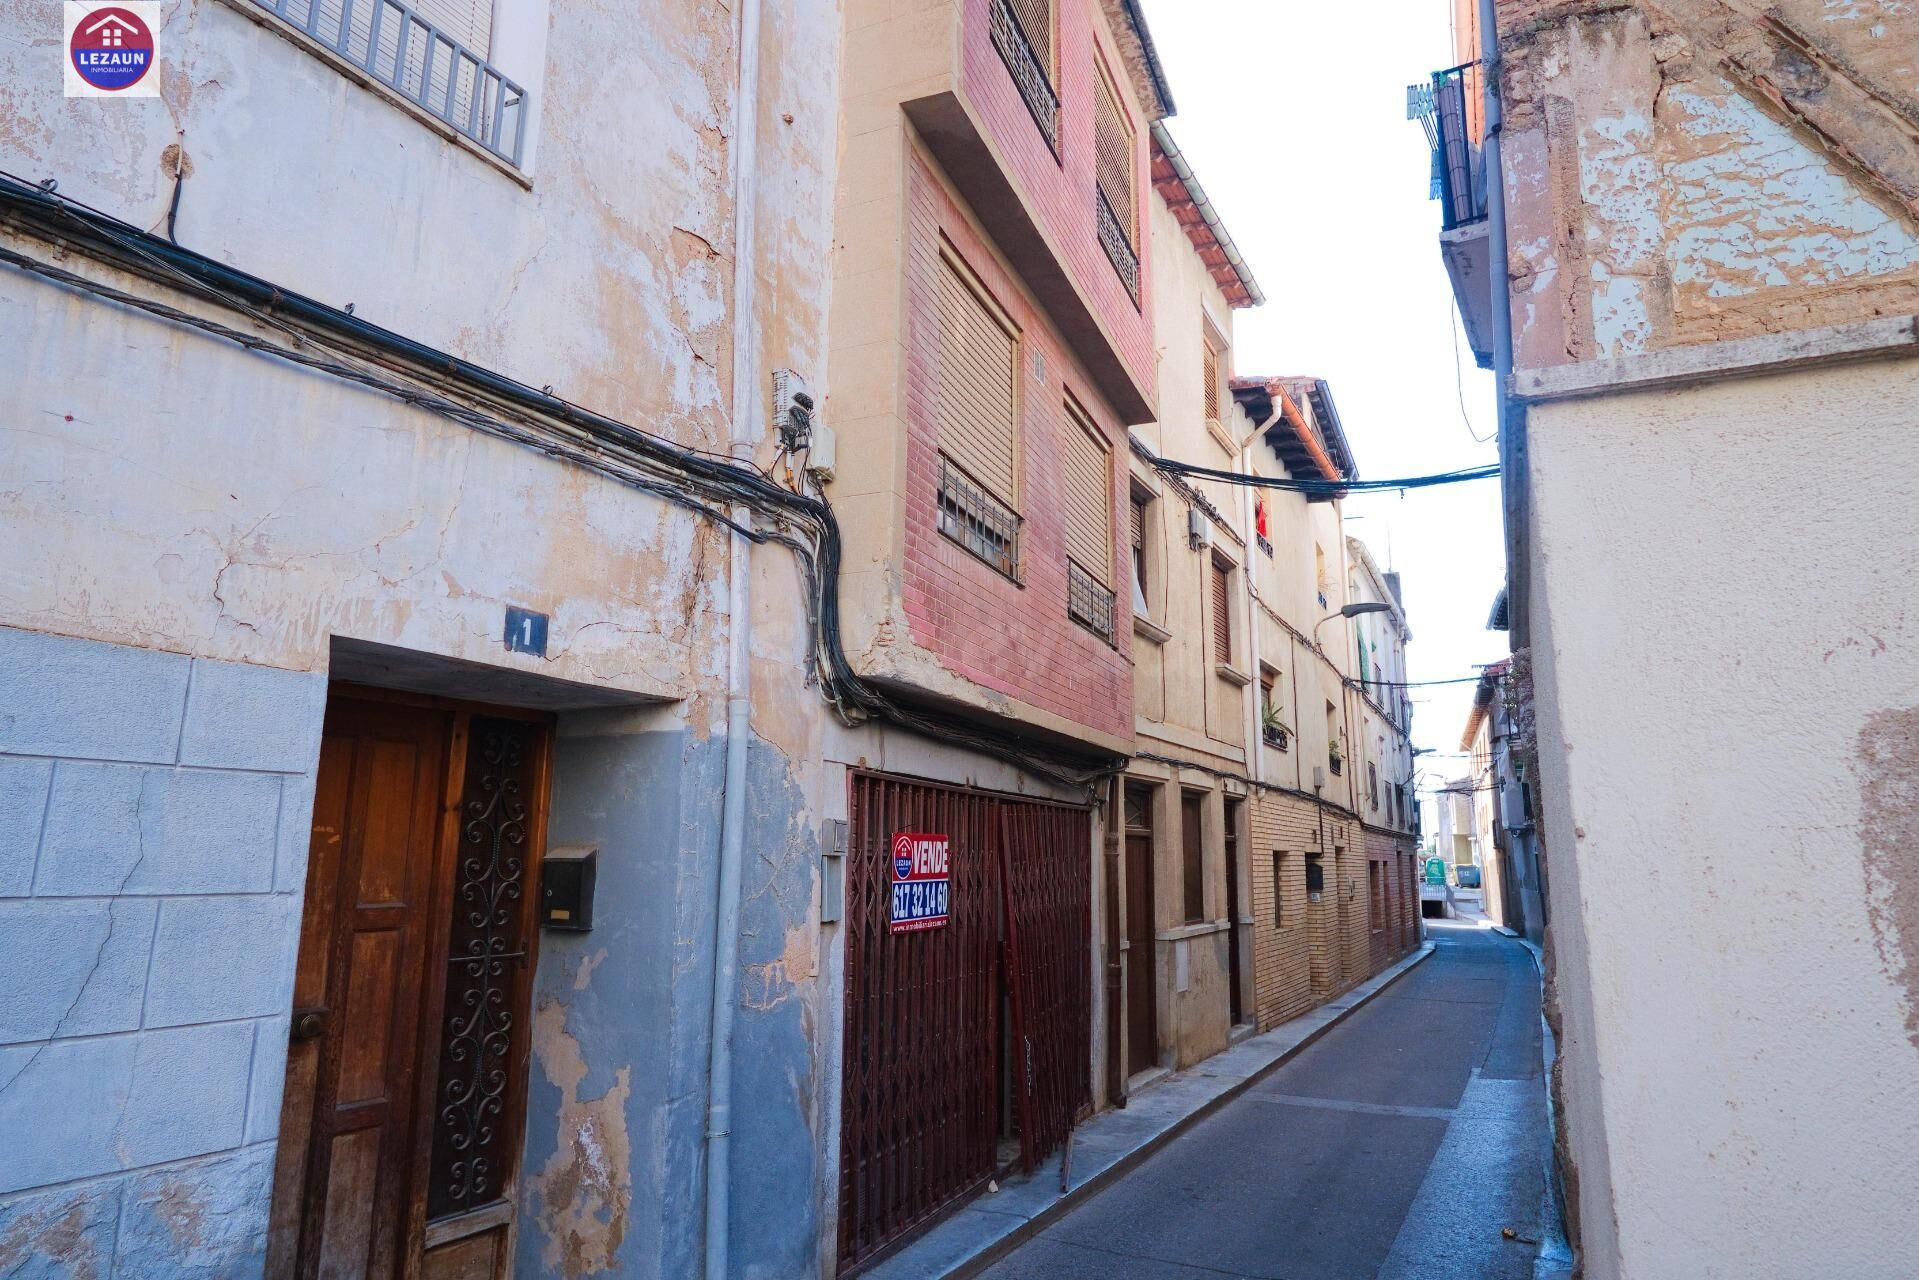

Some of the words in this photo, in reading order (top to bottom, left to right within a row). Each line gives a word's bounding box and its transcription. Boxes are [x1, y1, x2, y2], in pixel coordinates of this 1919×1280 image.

[523, 617, 532, 646] 1
[913, 840, 949, 874] VENDE
[893, 884, 911, 919] 617
[911, 883, 924, 917] 32
[925, 882, 936, 916] 14
[937, 882, 948, 914] 60
